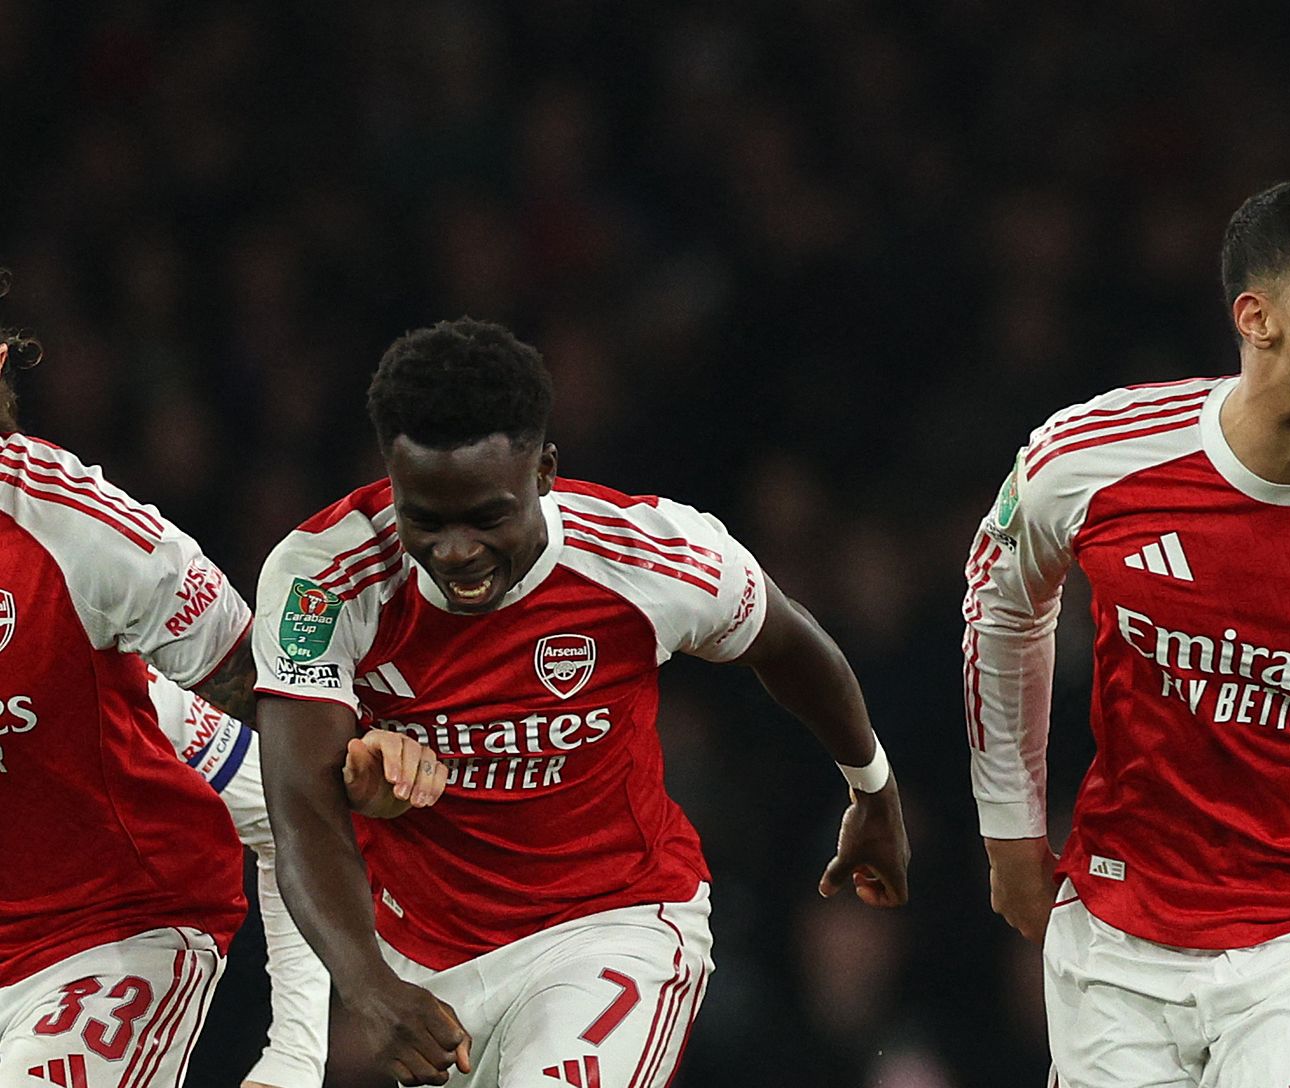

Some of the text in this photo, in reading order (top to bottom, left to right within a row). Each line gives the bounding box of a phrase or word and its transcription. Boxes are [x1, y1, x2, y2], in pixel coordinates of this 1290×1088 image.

[285, 612, 333, 624] Carabao
[293, 622, 316, 633] Cup
[298, 648, 311, 657] EFL
[544, 645, 588, 657] Arsenal
[217, 718, 237, 753] CAPT
[378, 708, 612, 755] mirates
[32, 974, 155, 1062] 33
[580, 967, 641, 1047] 7
